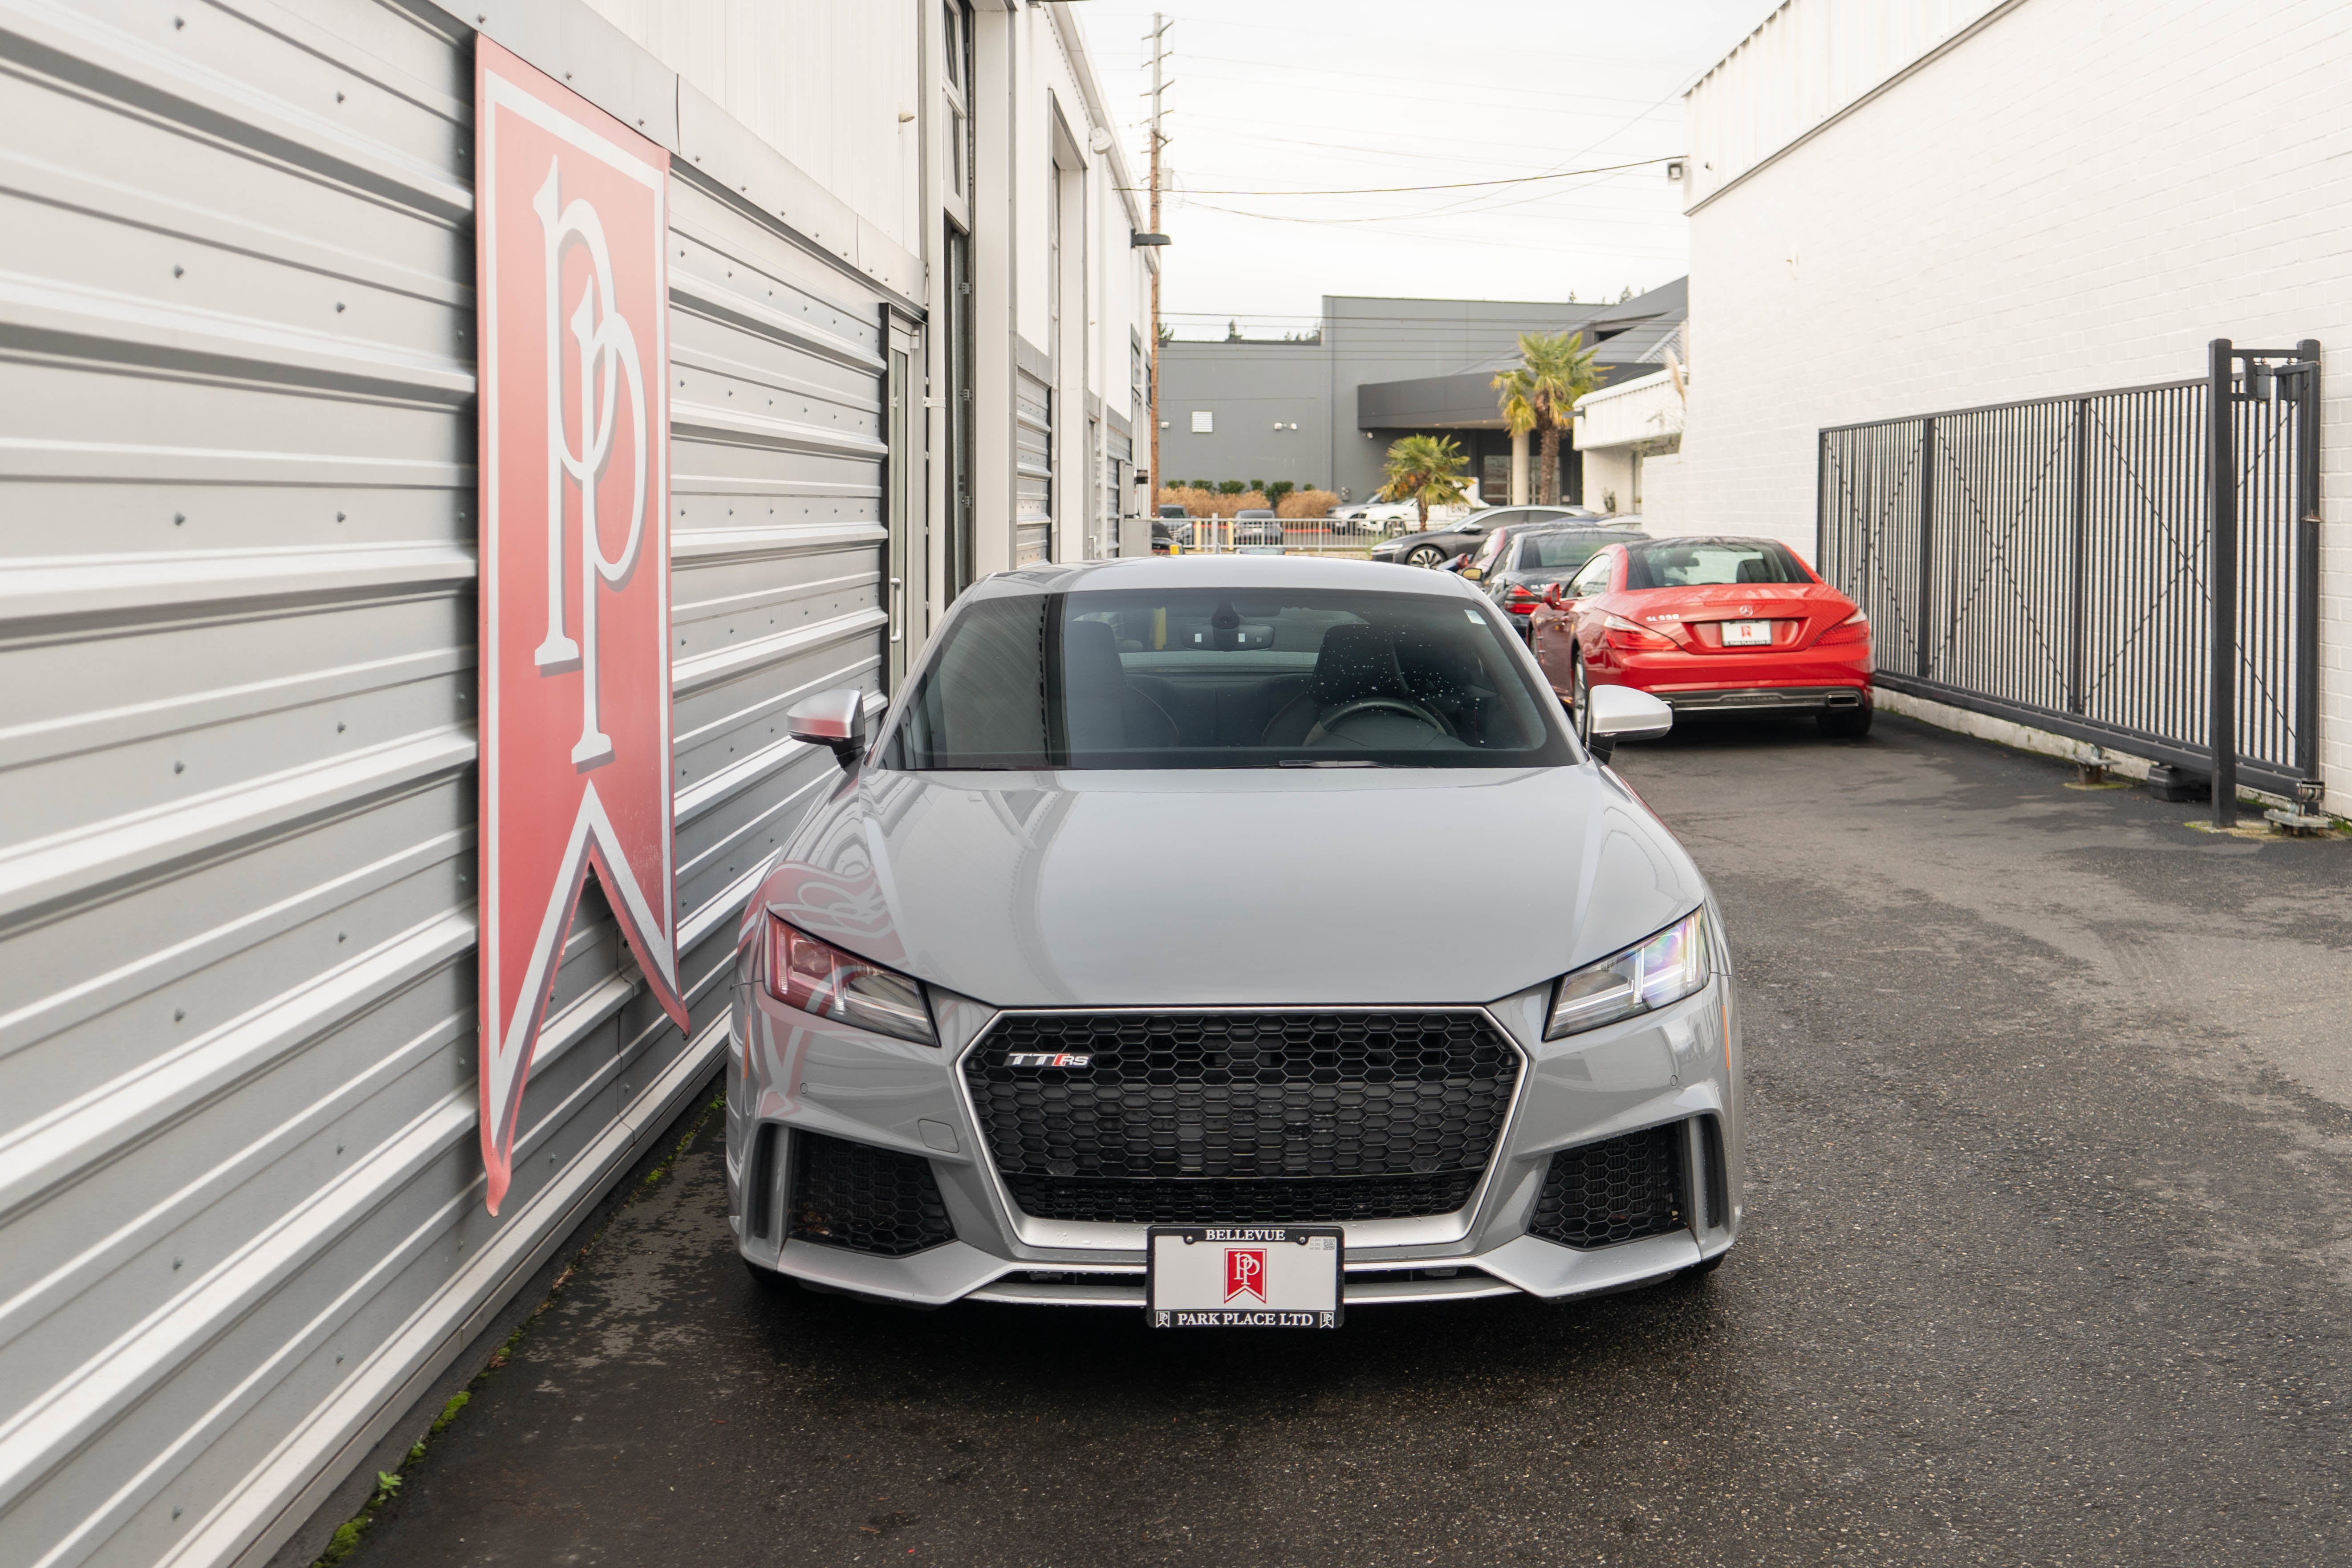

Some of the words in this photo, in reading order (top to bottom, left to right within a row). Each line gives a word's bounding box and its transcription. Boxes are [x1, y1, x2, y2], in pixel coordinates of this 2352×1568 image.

[1206, 1230, 1286, 1241] BELLEVUE
[1177, 1313, 1222, 1325] PARK
[1223, 1313, 1276, 1326] PLACE
[1279, 1314, 1314, 1326] LTD
